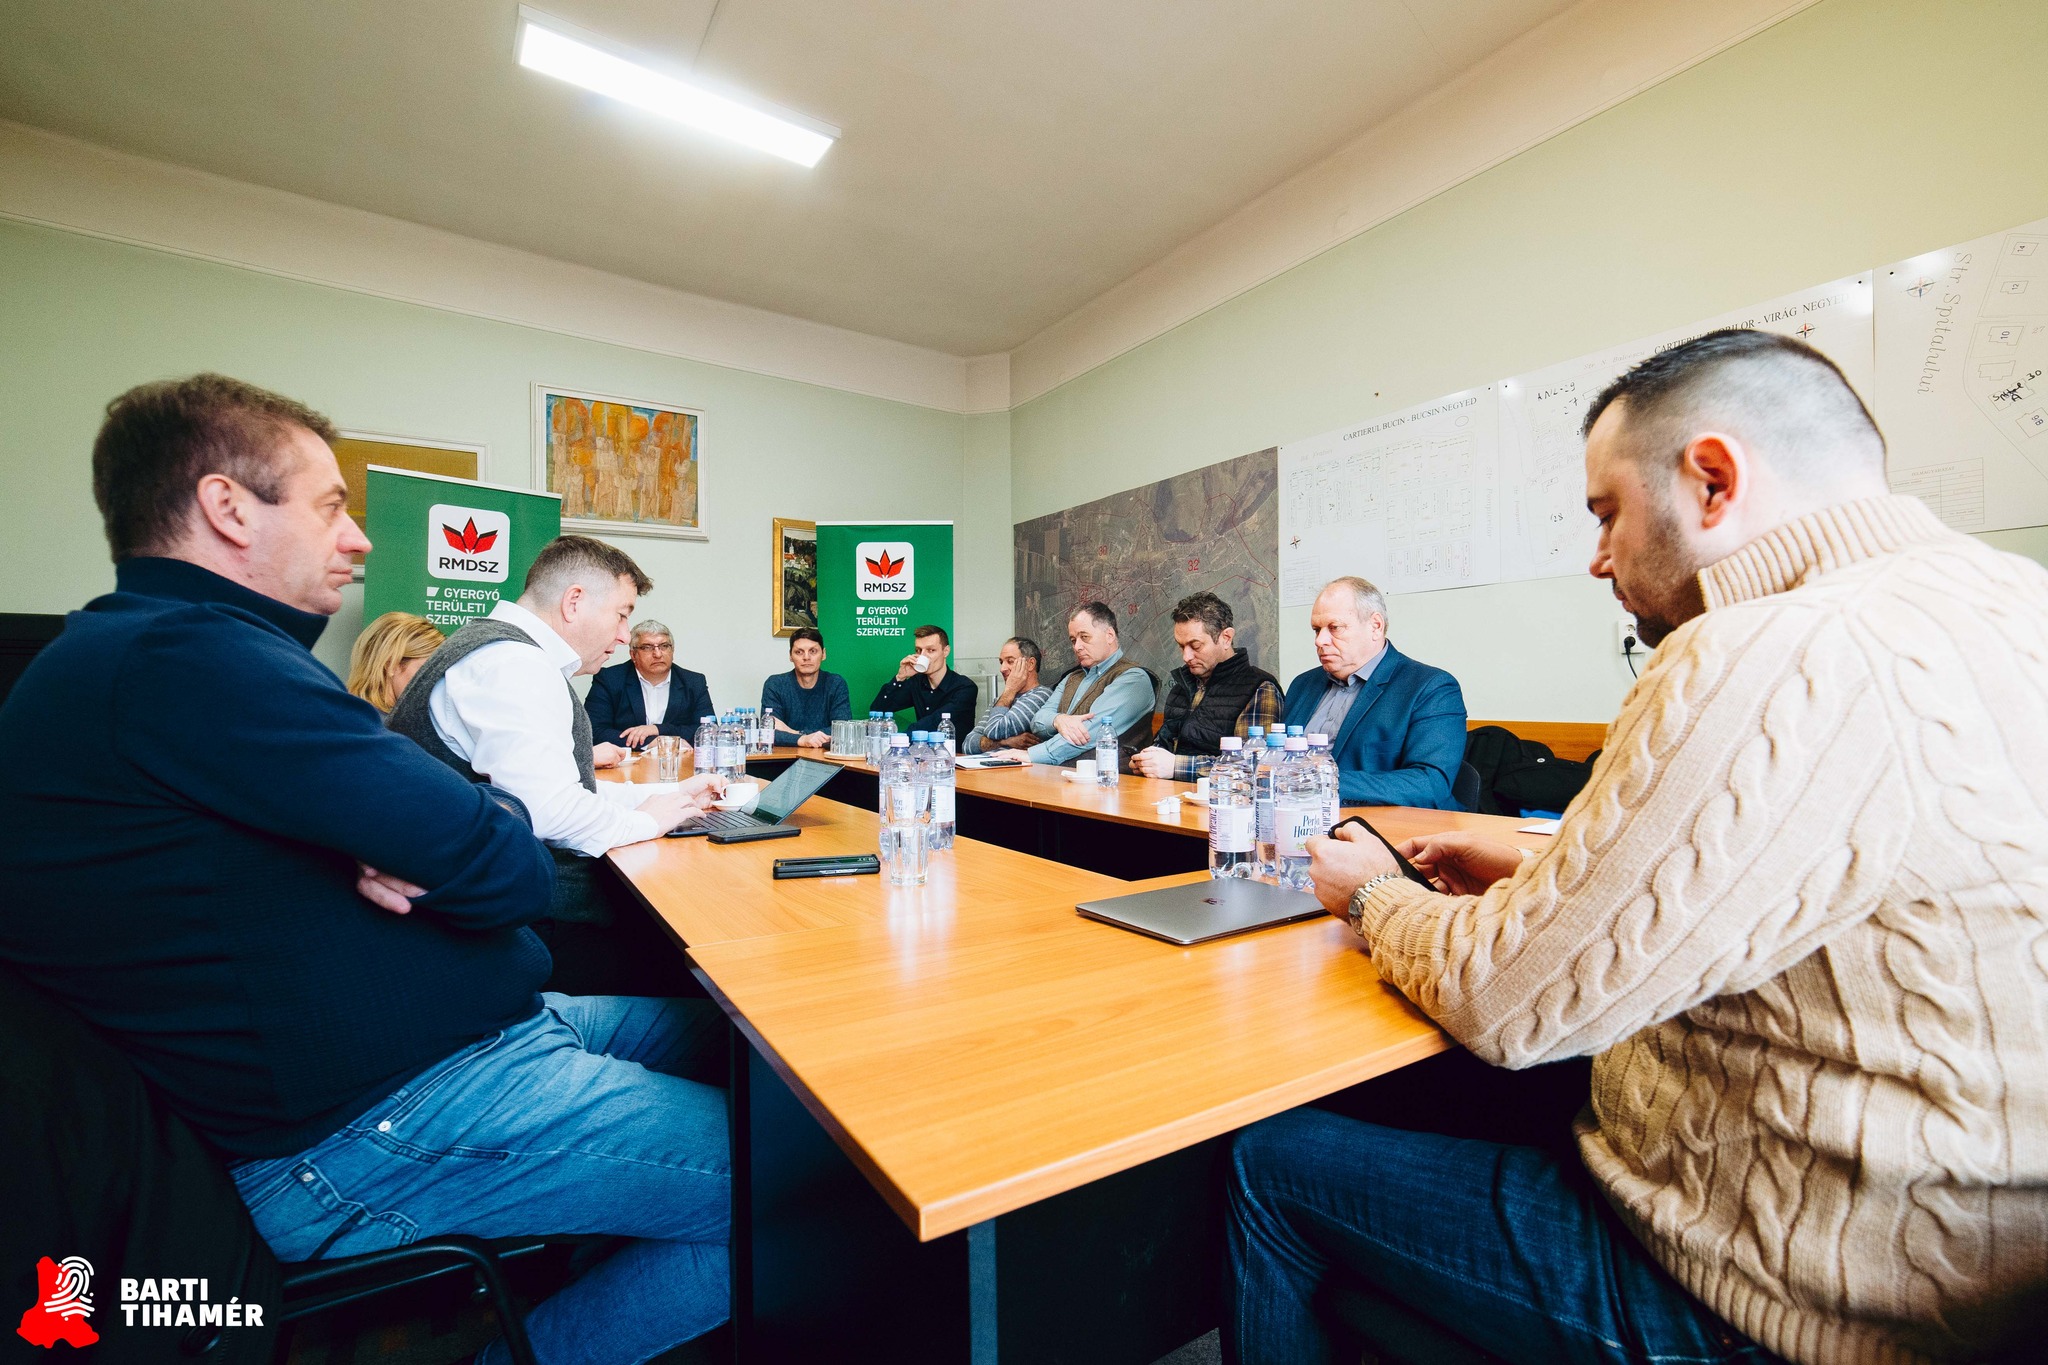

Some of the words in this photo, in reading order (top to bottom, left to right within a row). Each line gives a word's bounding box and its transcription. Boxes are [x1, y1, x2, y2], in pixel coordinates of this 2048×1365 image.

[1946, 252, 1973, 288] Str.
[2011, 283, 2020, 291] 12
[1763, 306, 1798, 323] VIRÁG
[1802, 293, 1850, 314] NEGYED
[2000, 330, 2011, 341] 10
[1916, 293, 1962, 395] Spitalului
[1342, 423, 1382, 441] CARTIERUL
[1382, 416, 1406, 433] BUCIN
[1410, 407, 1440, 423] BUCSIN
[1441, 396, 1478, 415] NEGYED
[439, 556, 499, 574] RMDSZ
[1187, 558, 1200, 572] 32
[864, 582, 907, 593] RMDSZ
[443, 588, 501, 601] GYERGYÓ
[425, 599, 487, 614] TERÜLETI
[867, 604, 910, 616] GYERGYÓ
[425, 613, 486, 626] SZERVE
[856, 615, 899, 626] TERÜLETI
[856, 627, 907, 637] SZERVEZET
